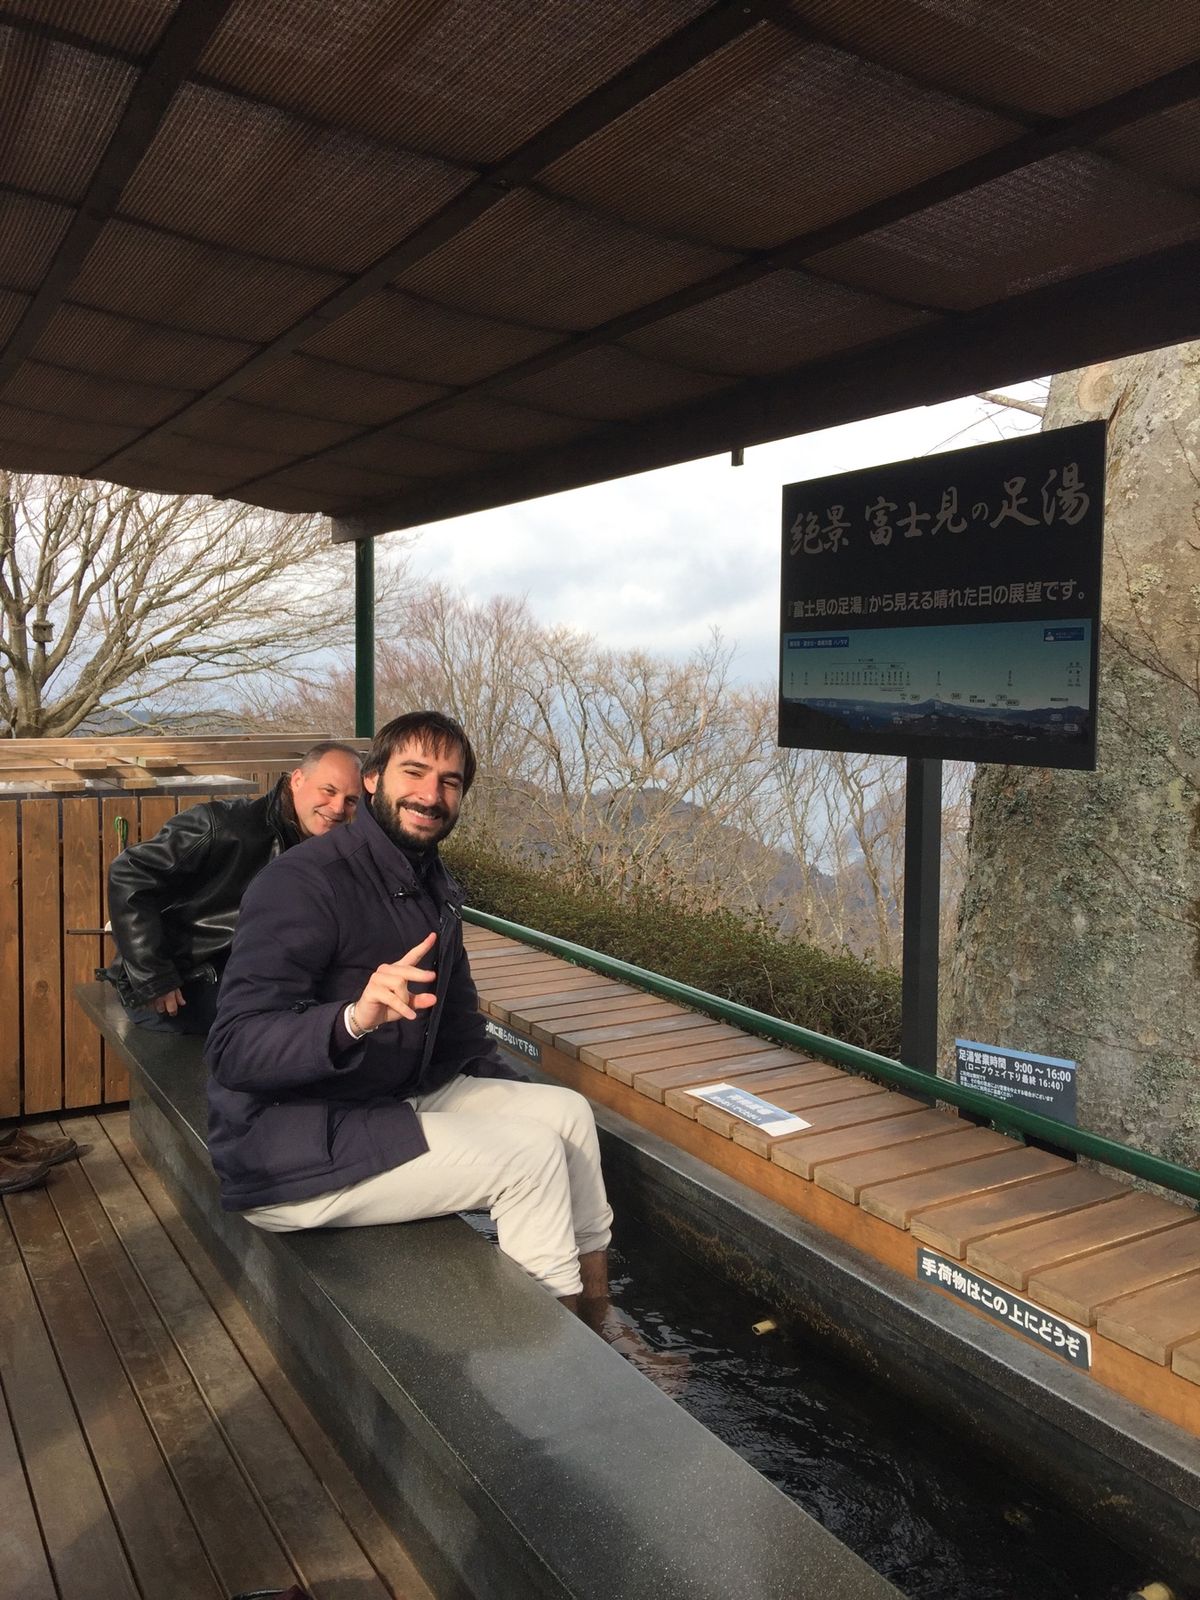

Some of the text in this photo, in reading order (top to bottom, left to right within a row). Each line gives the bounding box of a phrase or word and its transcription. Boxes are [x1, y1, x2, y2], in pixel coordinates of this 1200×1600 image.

[790, 462, 1090, 555] 絶景 富士見の足湯
[958, 1048, 1006, 1070] 足湯営業時間
[1014, 1061, 1033, 1074] 9:00
[1046, 1068, 1072, 1082] 16:00
[921, 1257, 1080, 1358] 手荷物はこの上にどうぞ
